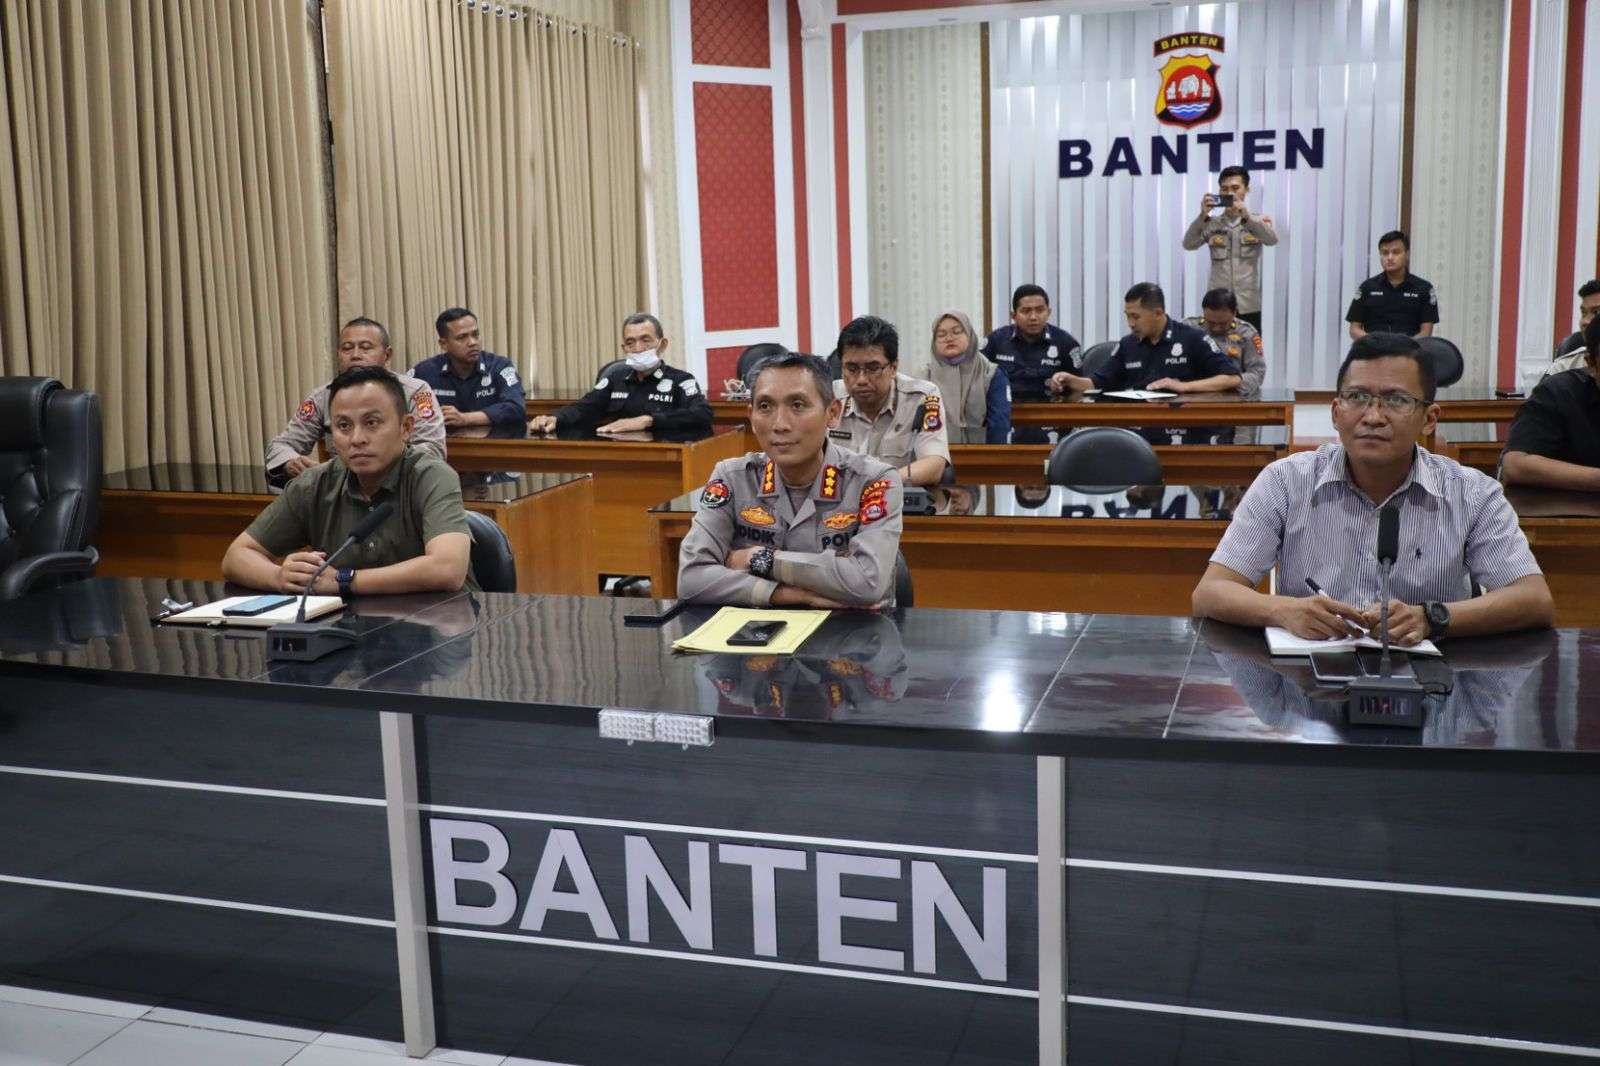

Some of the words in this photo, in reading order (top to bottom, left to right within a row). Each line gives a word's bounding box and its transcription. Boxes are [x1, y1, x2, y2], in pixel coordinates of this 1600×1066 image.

[1161, 35, 1218, 49] BANTEN
[1059, 128, 1324, 178] BANTEN
[648, 393, 673, 402] POLRI
[429, 817, 1007, 982] BANTEN
